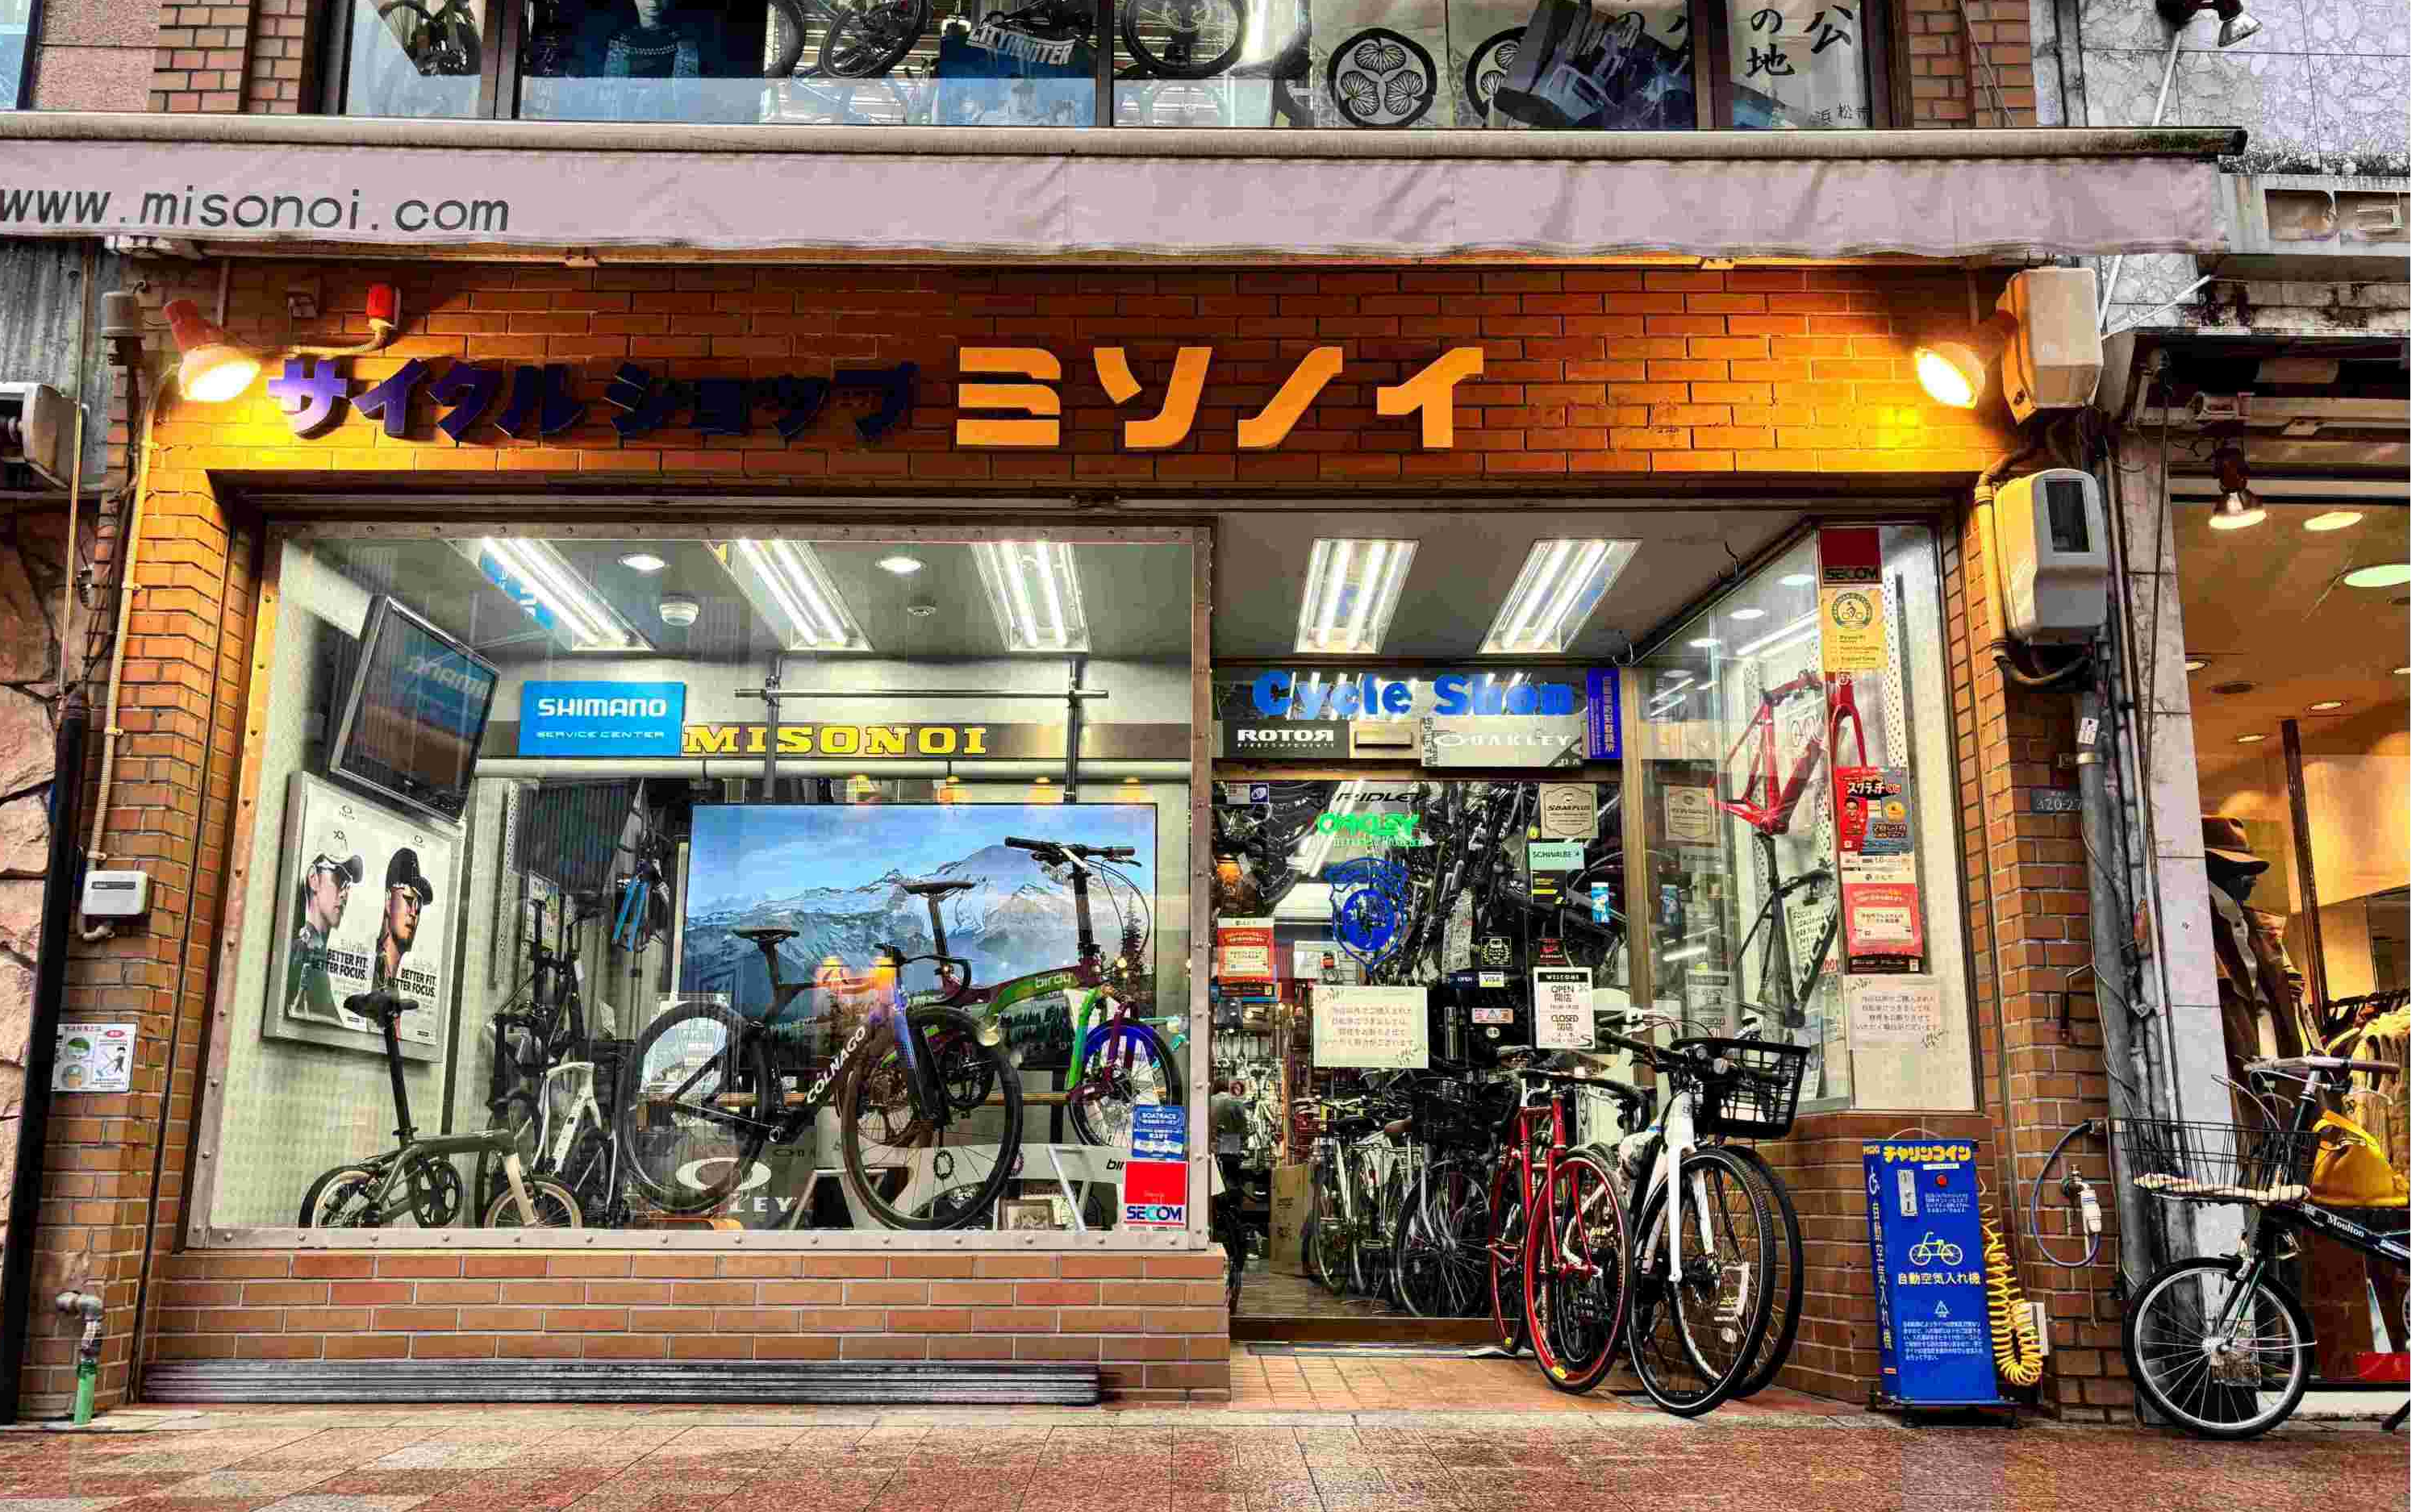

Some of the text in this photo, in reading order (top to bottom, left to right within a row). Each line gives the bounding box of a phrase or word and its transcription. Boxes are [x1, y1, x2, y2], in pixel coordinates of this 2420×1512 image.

[268, 346, 1484, 448] サイクル ショップ ミソノイ
[1252, 670, 1412, 720] Cycle
[537, 698, 667, 718] SHIMANO
[536, 731, 666, 739] SERVICE CENTER
[684, 725, 987, 754] MISONOI
[1237, 729, 1334, 742] ROTOR
[327, 949, 369, 970] BETTER FIT.
[339, 964, 367, 981] FOCUS.
[401, 968, 437, 987] BETTER FIT.
[1036, 971, 1073, 989] birdy
[412, 983, 436, 998] FOCUS.
[1551, 985, 1575, 993] OPEN
[1551, 1014, 1579, 1023] CLOSED
[806, 1026, 866, 1105] COLNAGO
[1883, 1144, 1972, 1164] チャリンコイン
[1126, 1206, 1183, 1220] SECOM
[2326, 1214, 2365, 1238] Moulton
[1898, 1272, 1981, 1285] 自動空気入れ機
